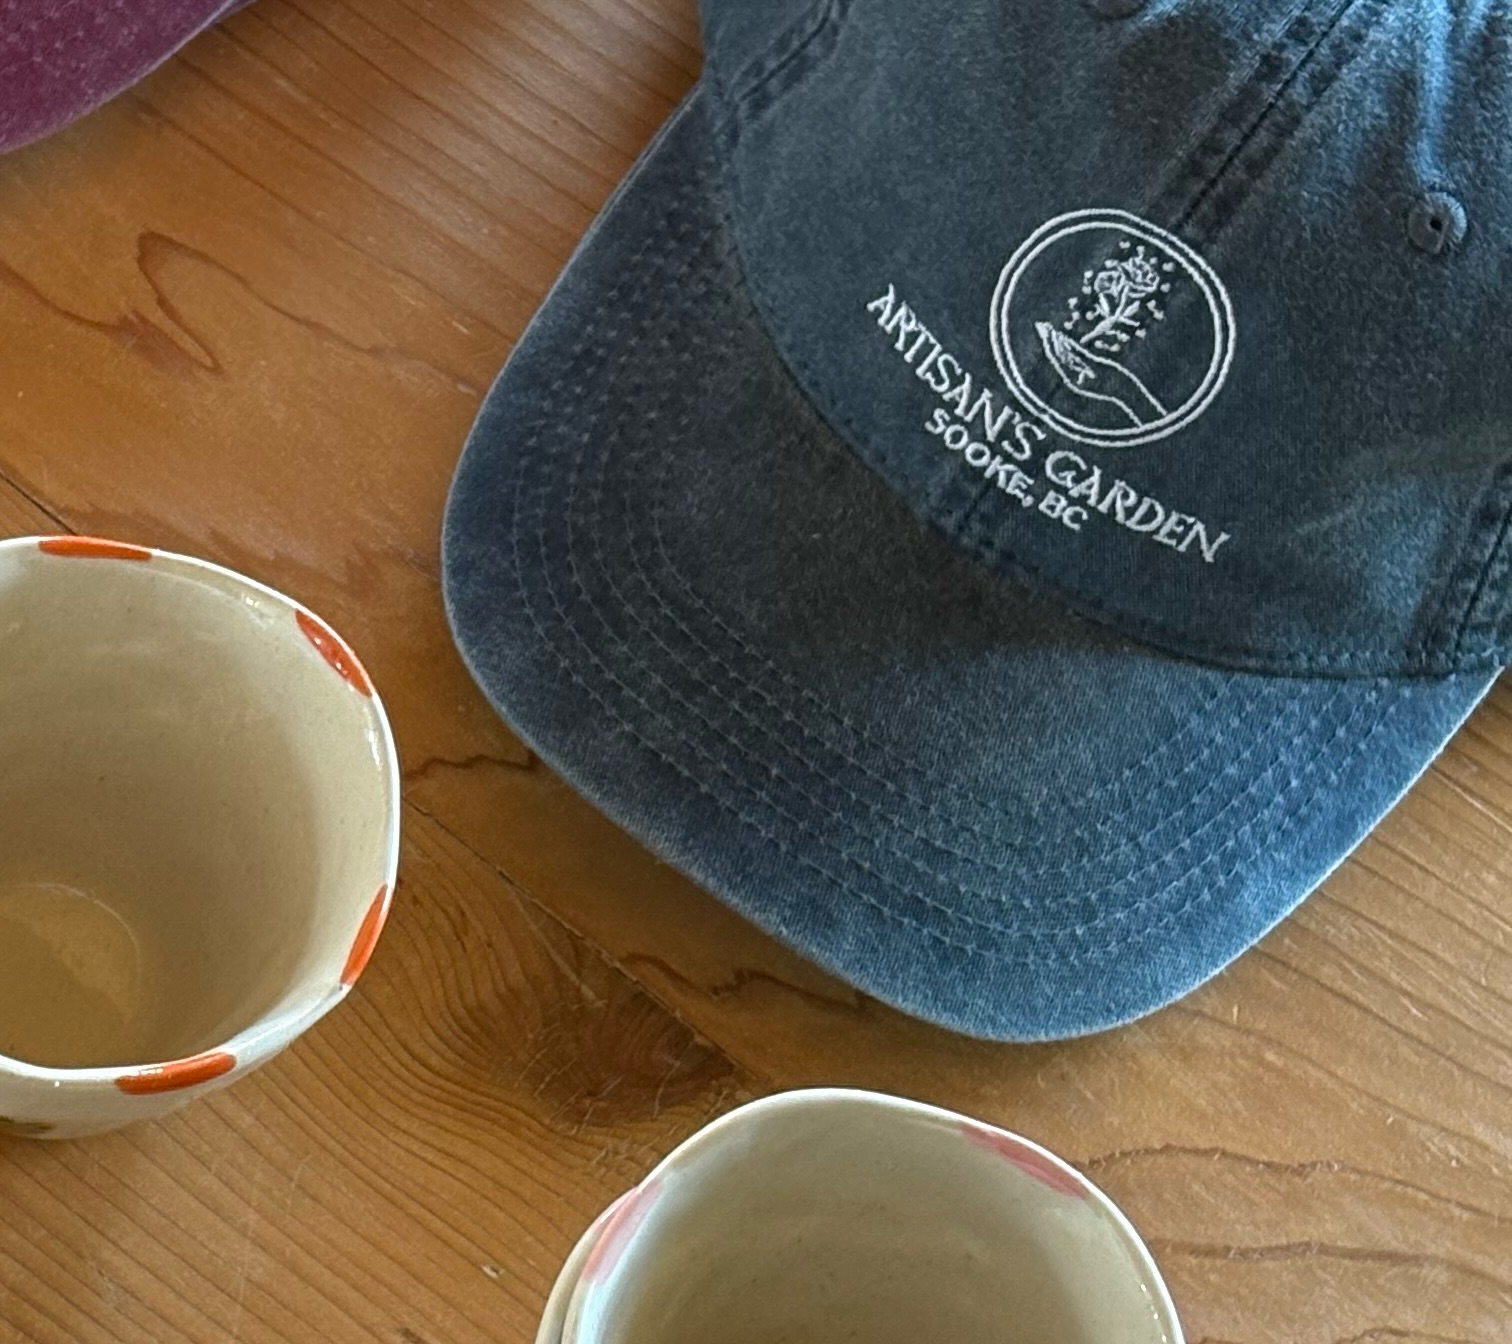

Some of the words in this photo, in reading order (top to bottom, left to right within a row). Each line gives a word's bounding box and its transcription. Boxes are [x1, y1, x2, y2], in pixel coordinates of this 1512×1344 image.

[866, 283, 1047, 462] ARTISAN'S
[1044, 450, 1231, 563] GARDEN
[924, 407, 1035, 508] SOOKE,
[1037, 490, 1089, 531] BC
